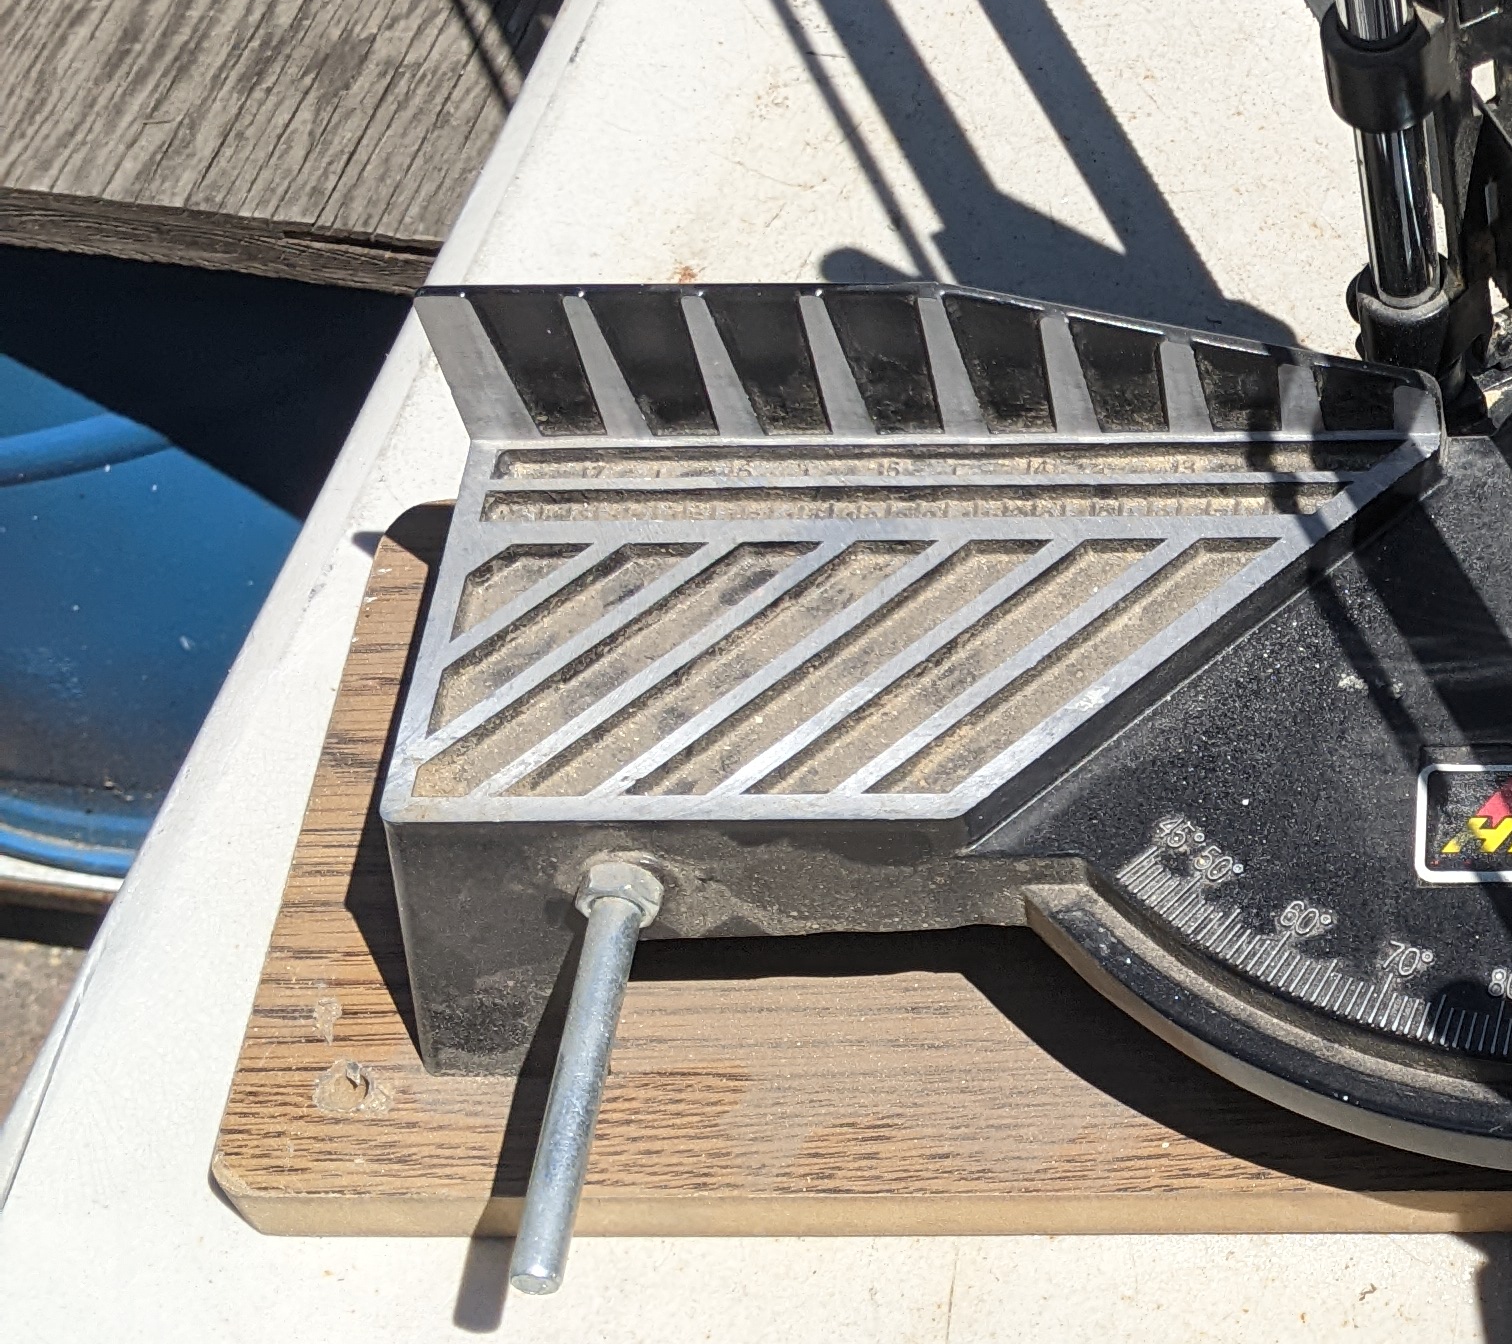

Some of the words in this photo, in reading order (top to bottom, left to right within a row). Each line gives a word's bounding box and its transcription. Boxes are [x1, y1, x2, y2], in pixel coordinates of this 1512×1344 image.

[1157, 813, 1206, 848] 45°
[1193, 844, 1245, 881] 50°
[1279, 900, 1333, 935] 60°
[1382, 939, 1435, 976] 70°
